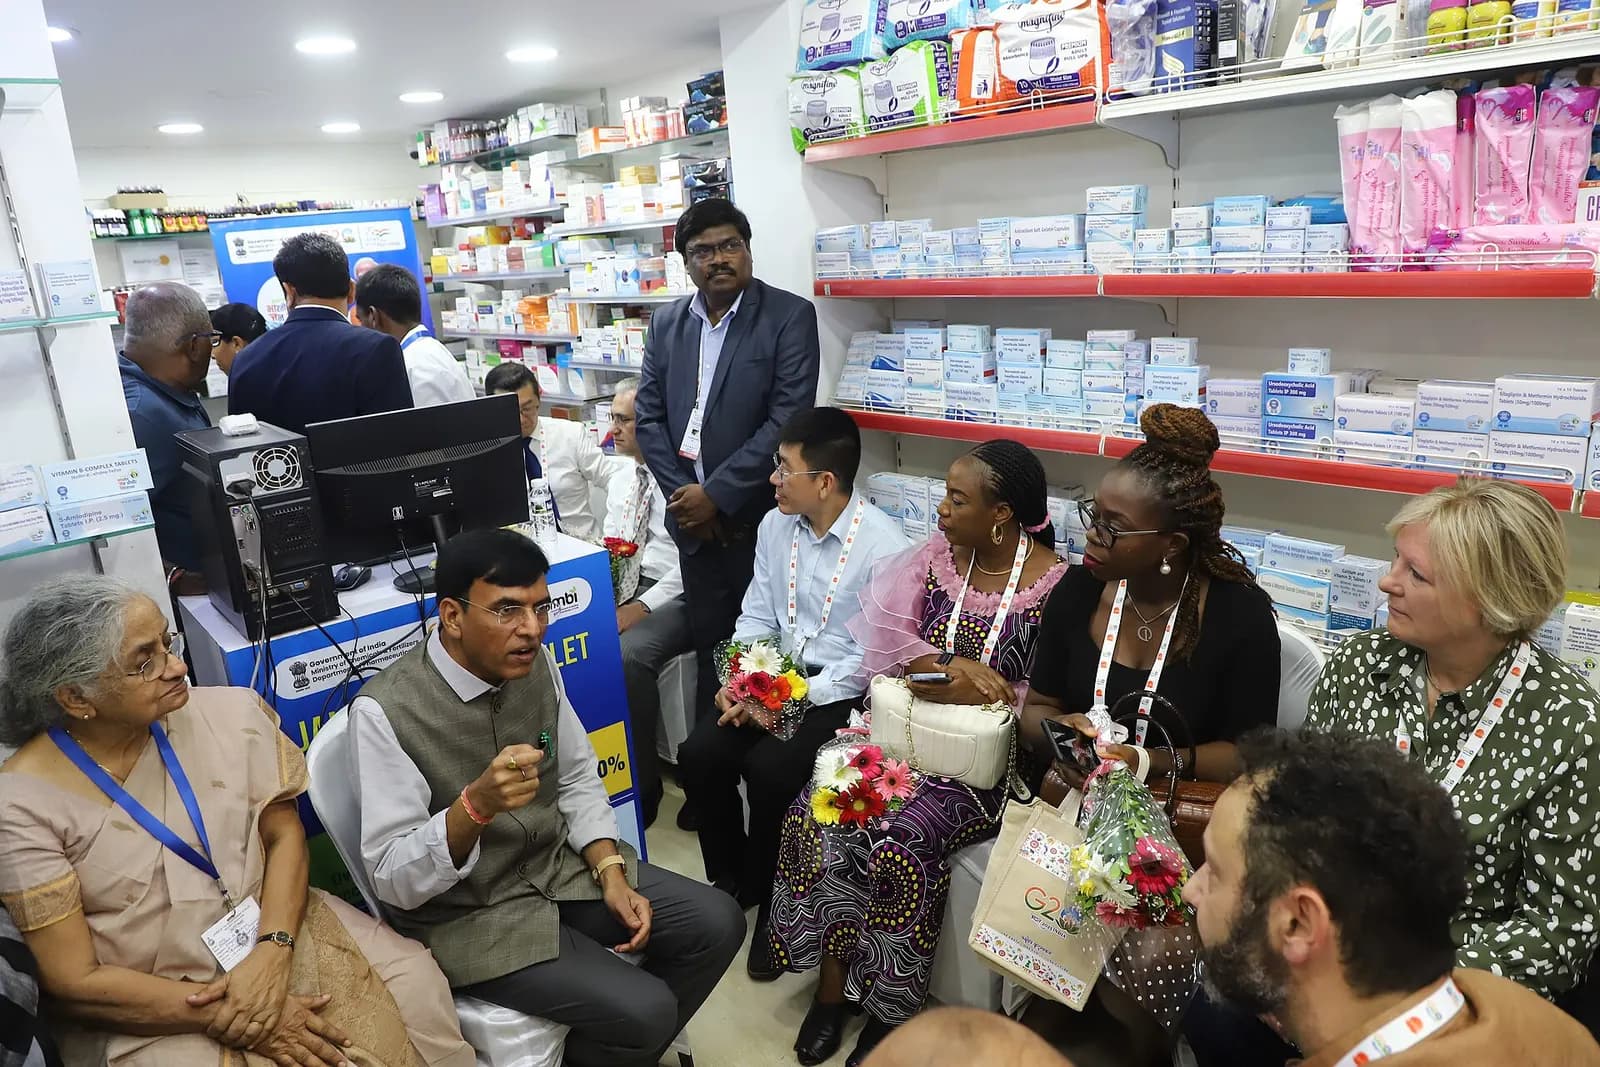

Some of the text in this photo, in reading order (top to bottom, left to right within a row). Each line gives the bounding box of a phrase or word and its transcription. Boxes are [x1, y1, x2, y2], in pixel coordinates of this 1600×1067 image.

[907, 20, 916, 33] M
[816, 46, 823, 57] M
[1019, 81, 1028, 89] 10
[1034, 80, 1044, 88] XL
[51, 468, 78, 478] VITAMIN
[79, 463, 113, 473] B-COMPLEX
[114, 459, 138, 468] TABLETS
[58, 510, 102, 523] S-Amlodipine
[60, 520, 84, 529] Tablets
[367, 641, 386, 650] India
[311, 663, 338, 675] Ministry
[597, 753, 626, 778] 0%
